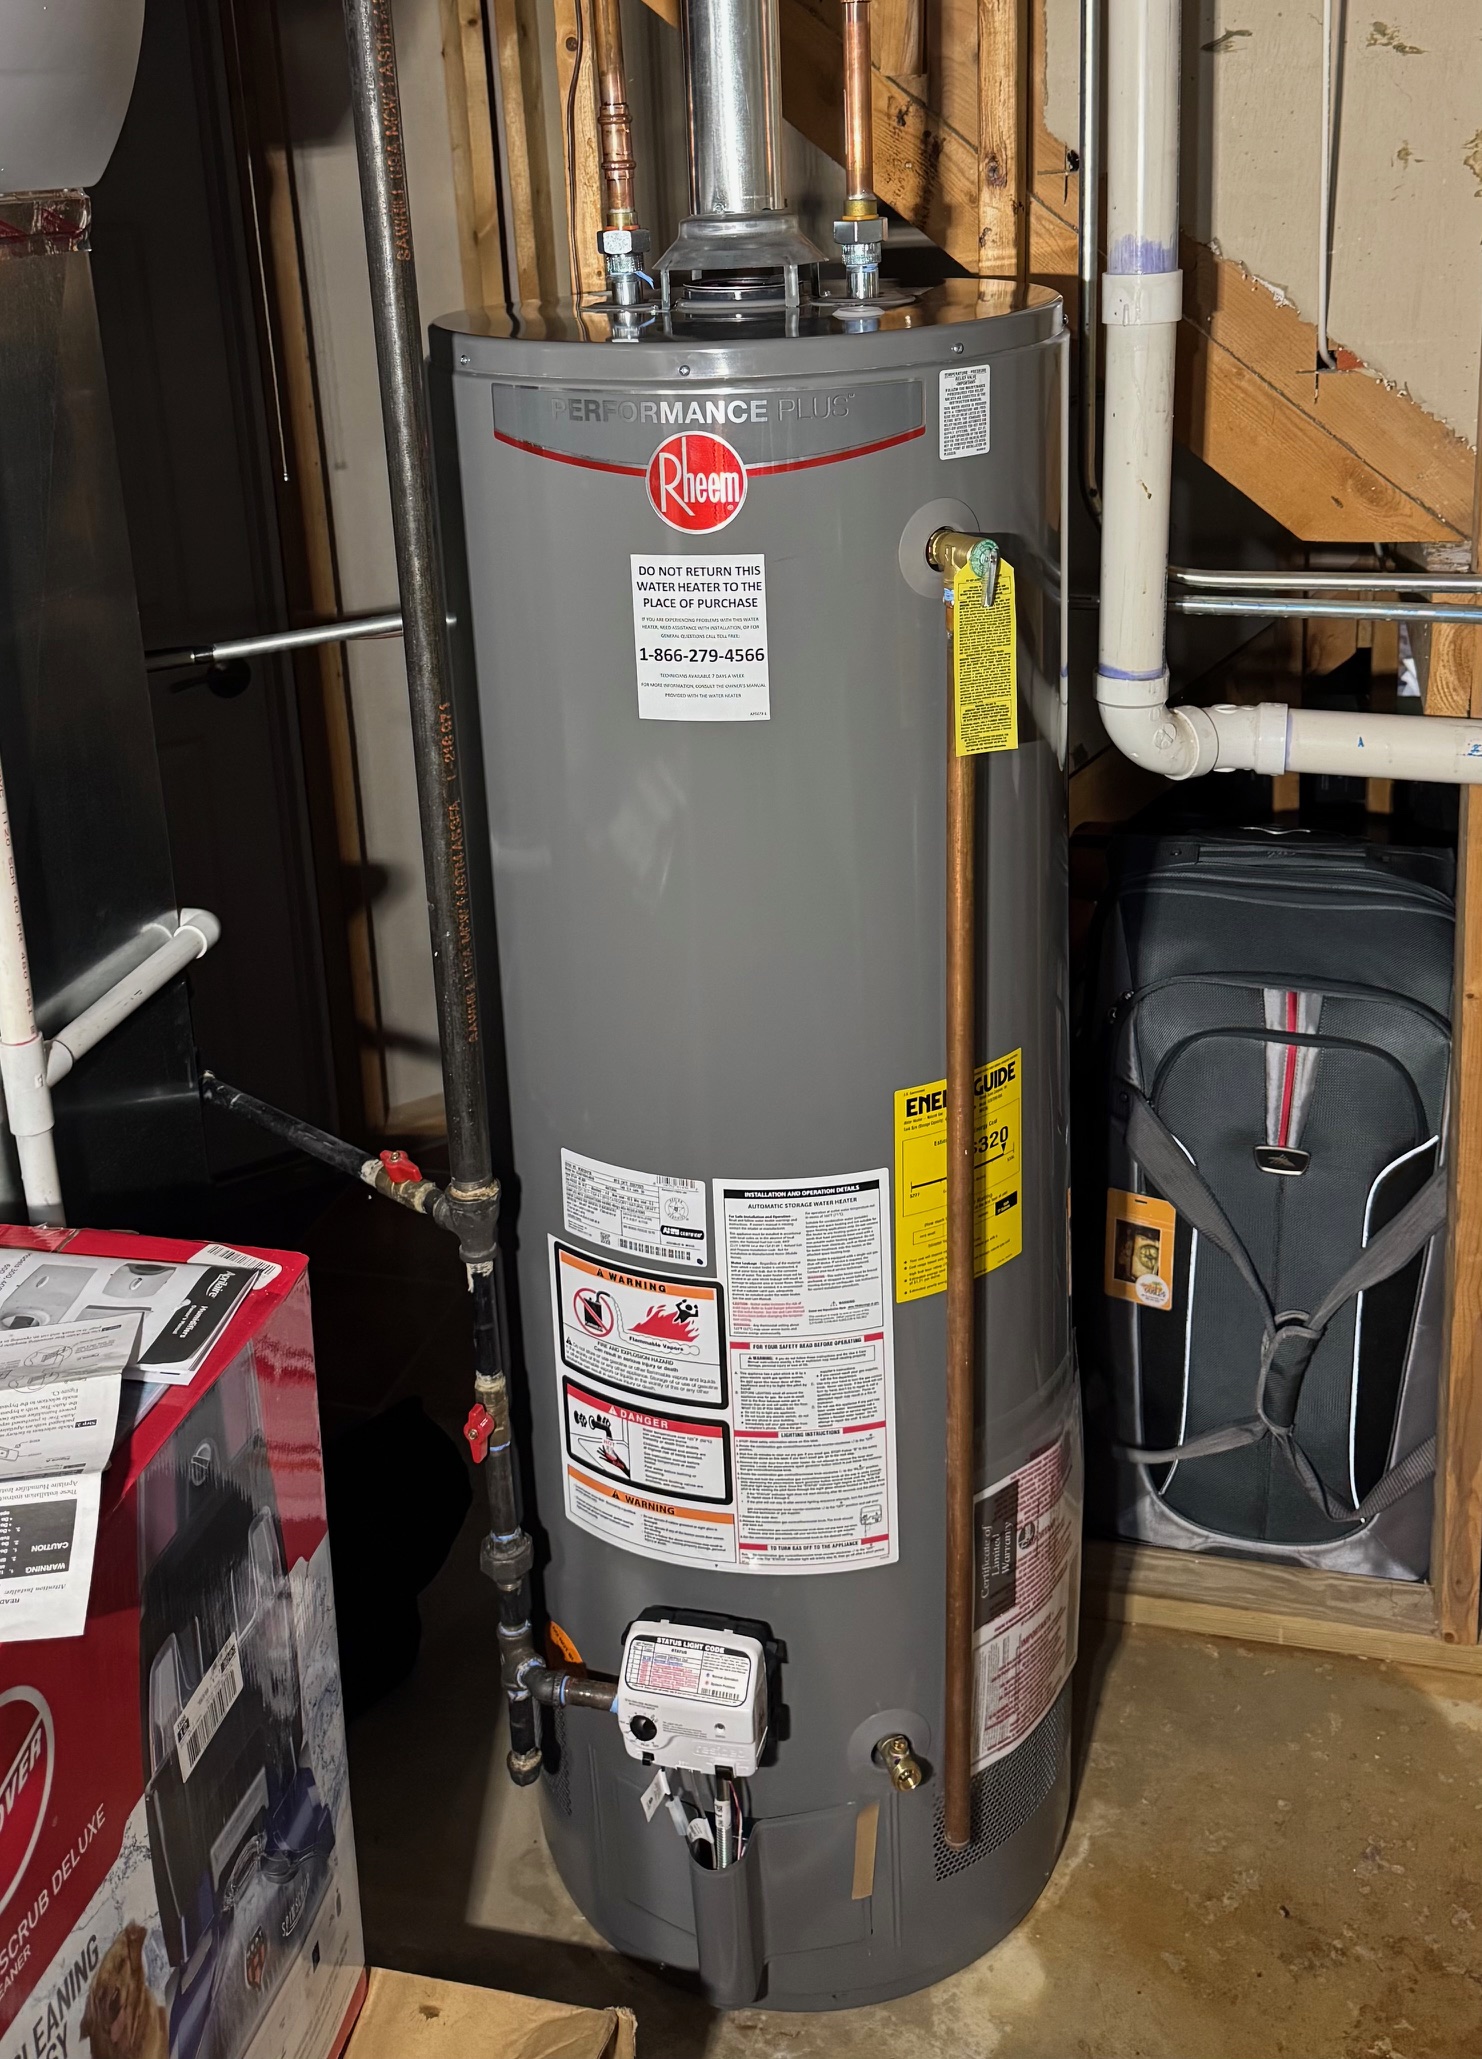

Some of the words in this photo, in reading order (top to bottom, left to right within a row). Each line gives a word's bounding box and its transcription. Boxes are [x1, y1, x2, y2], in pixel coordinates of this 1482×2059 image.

[552, 399, 768, 424] PERFORMANCE
[778, 395, 850, 421] PLUS
[659, 436, 740, 516] Rheem
[638, 566, 655, 576] DO
[659, 566, 683, 577] NOT
[686, 566, 732, 577] RETURN
[735, 565, 761, 576] THIS
[636, 581, 675, 592] WATER
[678, 582, 720, 592] HEATER
[723, 582, 739, 592] TO
[741, 581, 762, 591] THE
[643, 598, 676, 608] PLACE
[679, 598, 695, 608] OF
[697, 598, 758, 608] PURCHASE
[639, 647, 765, 662] 1-866-279-4566
[7, 854, 17, 886] SCH
[13, 894, 21, 915] 40
[16, 923, 25, 942] PR
[25, 988, 34, 1015] PSI
[744, 1190, 787, 1198] INSTALLATION
[802, 1187, 836, 1196] OPERATION
[836, 1184, 860, 1193] DETAILS
[784, 1201, 812, 1209] STORAGE
[835, 1197, 857, 1205] HEATER
[208, 1270, 236, 1298] Aprilaire
[608, 1271, 666, 1293] WARNING
[629, 1335, 661, 1347] Flammable
[663, 1344, 684, 1352] Vapors
[834, 1338, 861, 1346] OPERATING
[651, 1356, 674, 1366] HAZARD
[620, 1409, 669, 1429] DANGER
[625, 1494, 675, 1515] WARNING
[982, 1524, 993, 1537] of
[31, 1541, 69, 1552] CAUTION
[991, 1533, 1000, 1576] Limited
[1002, 1521, 1014, 1574] Warranty
[25, 1562, 65, 1574] WARNING
[981, 1538, 993, 1599] Certificate
[657, 1637, 683, 1647] STATUS
[683, 1641, 704, 1650] LIGHT
[705, 1645, 725, 1653] CODE
[52, 1803, 107, 1895] DELUXE
